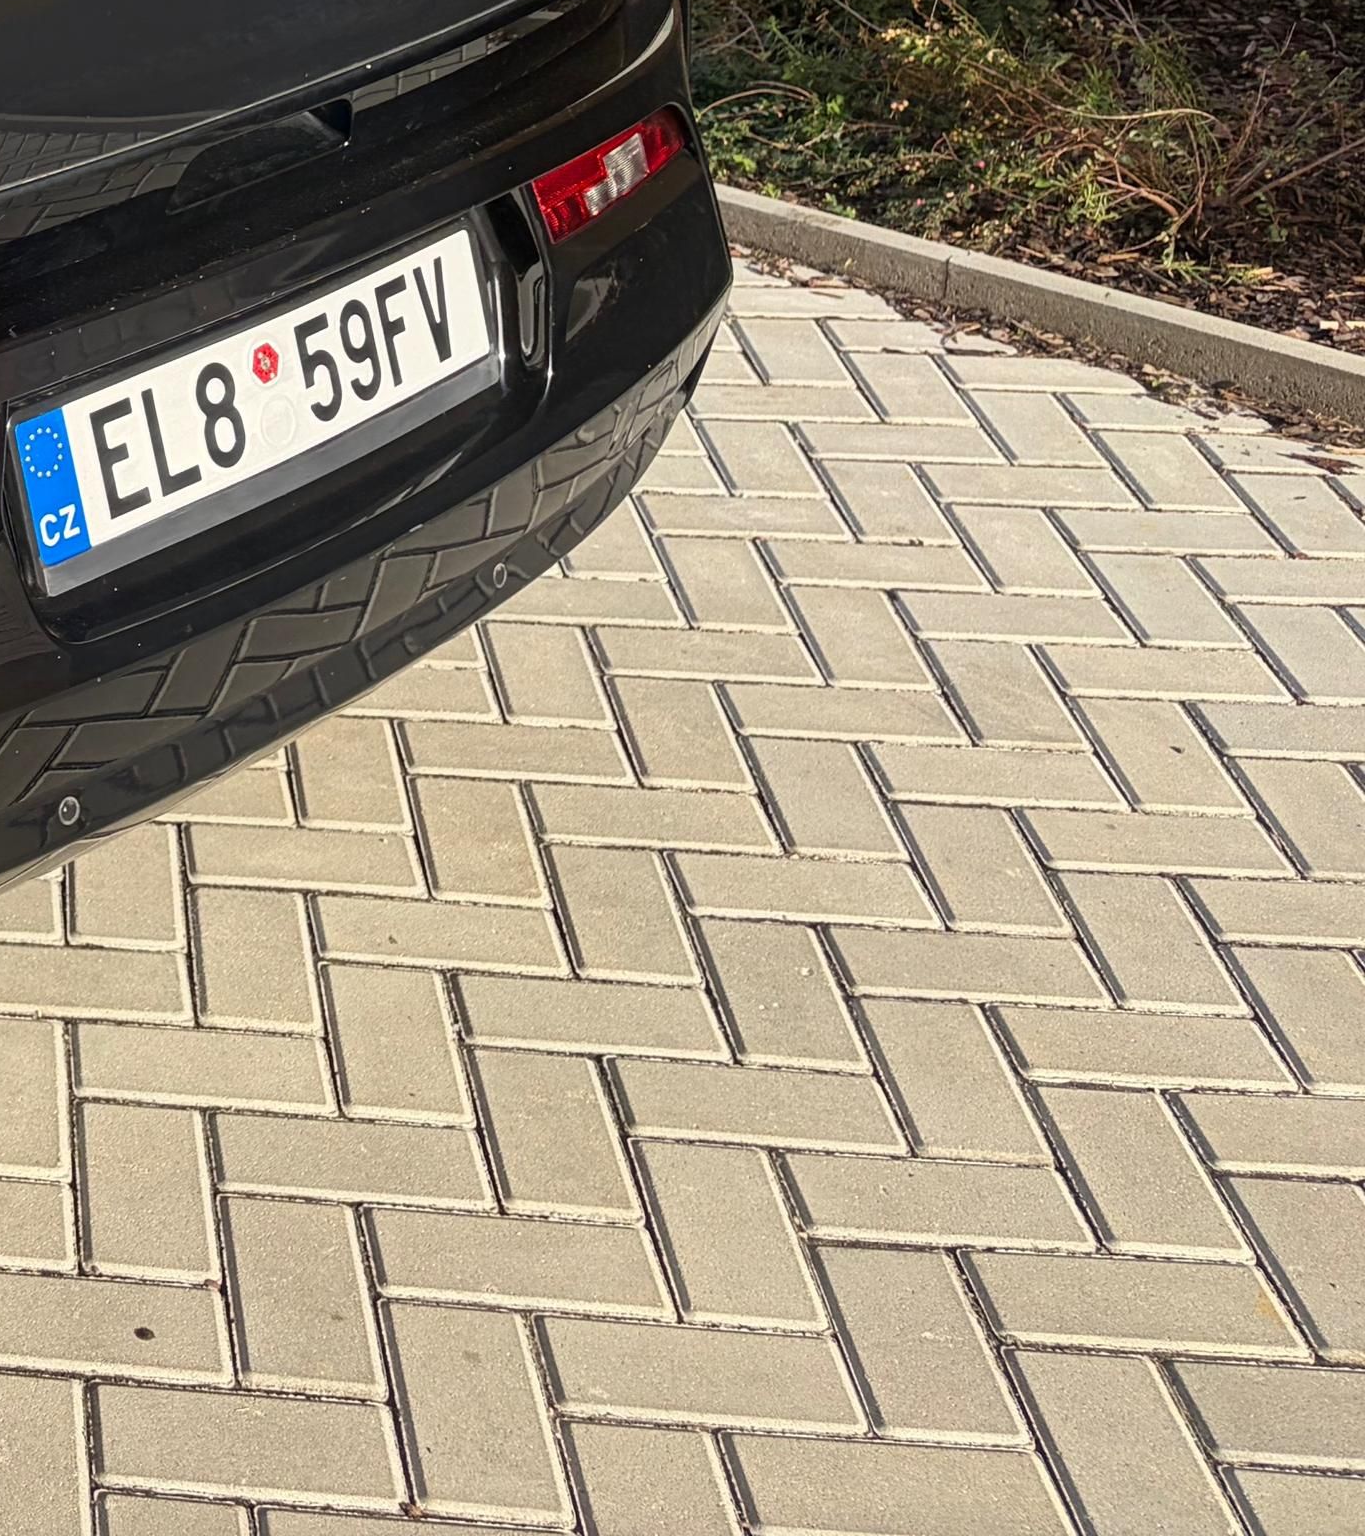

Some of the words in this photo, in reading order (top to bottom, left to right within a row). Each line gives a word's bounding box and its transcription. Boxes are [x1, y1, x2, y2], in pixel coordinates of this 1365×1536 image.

[89, 362, 246, 520] EL8
[294, 257, 452, 422] 59FV
[40, 504, 80, 547] CZ
